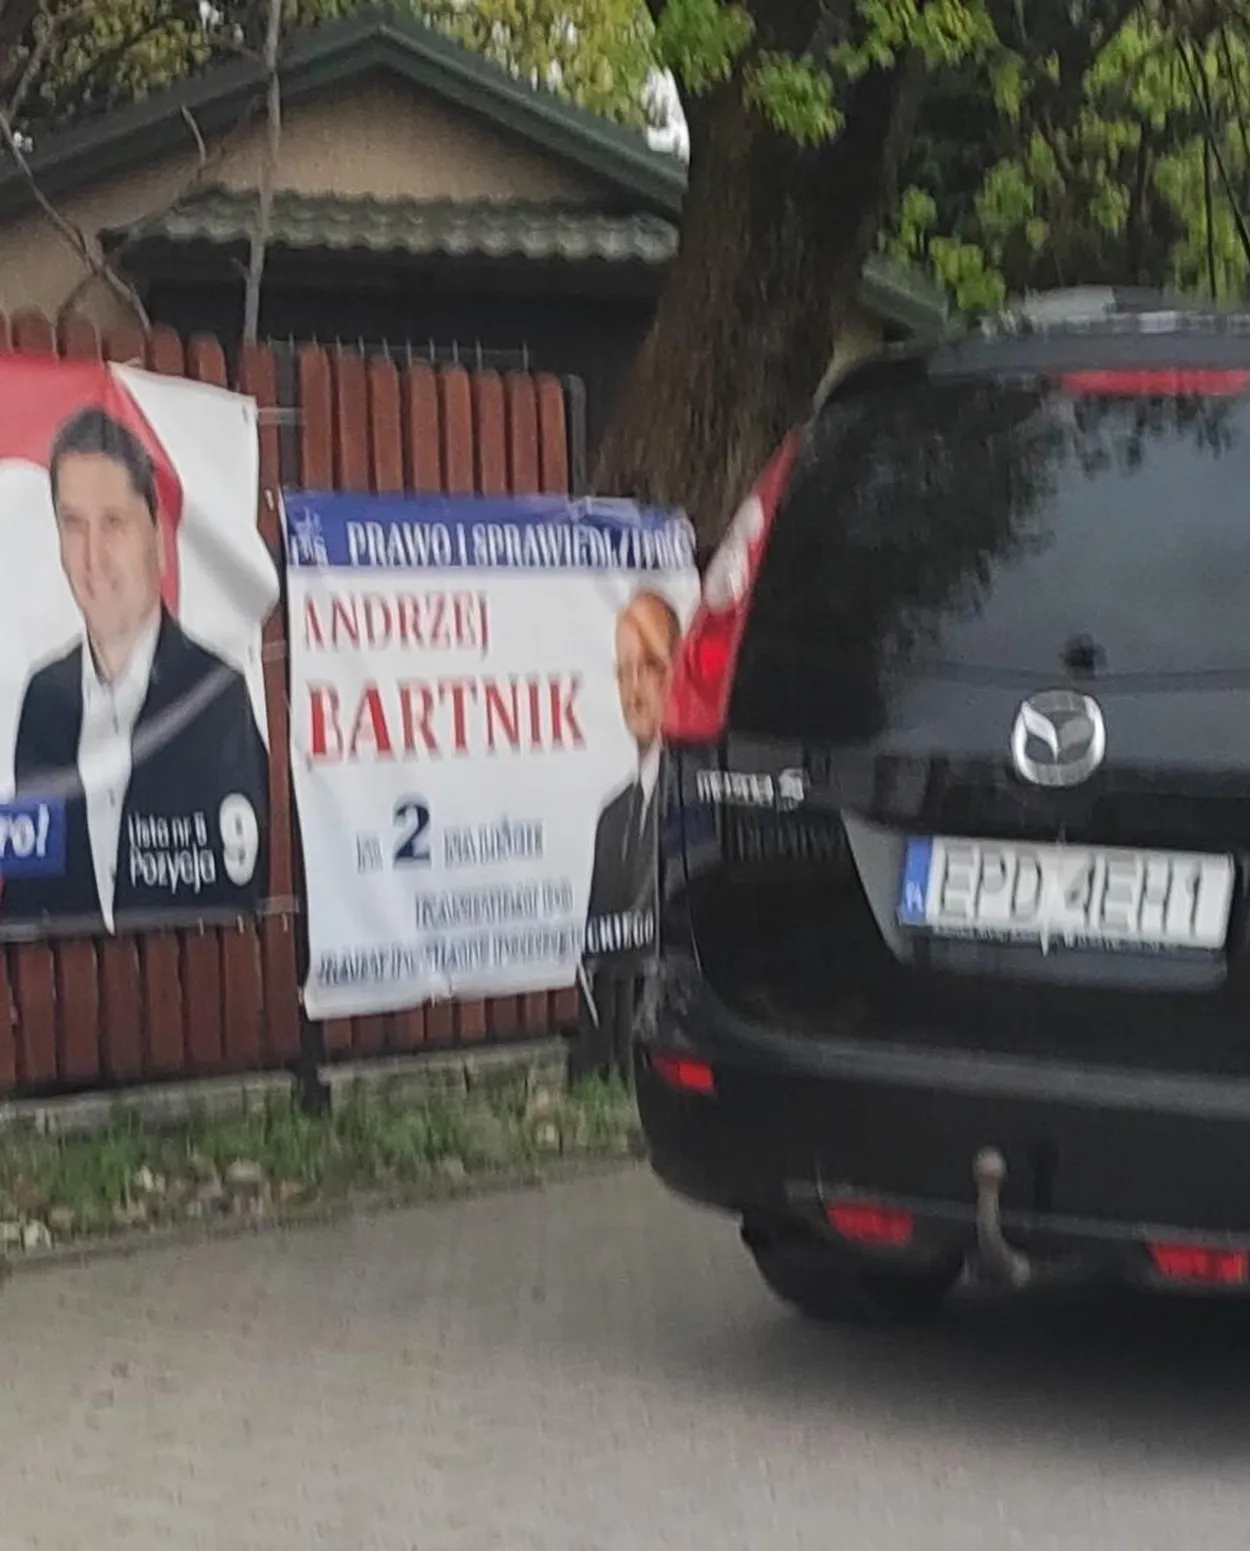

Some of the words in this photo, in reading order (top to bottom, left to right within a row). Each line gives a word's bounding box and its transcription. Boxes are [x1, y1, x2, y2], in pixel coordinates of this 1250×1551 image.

[346, 520, 452, 567] PRAWO
[303, 589, 490, 660] ANDRZEJ
[306, 672, 587, 767] BARTNIK
[130, 843, 216, 894] Pozycja
[219, 793, 259, 887] 9
[393, 795, 431, 868] 2
[942, 842, 1041, 923] EPD
